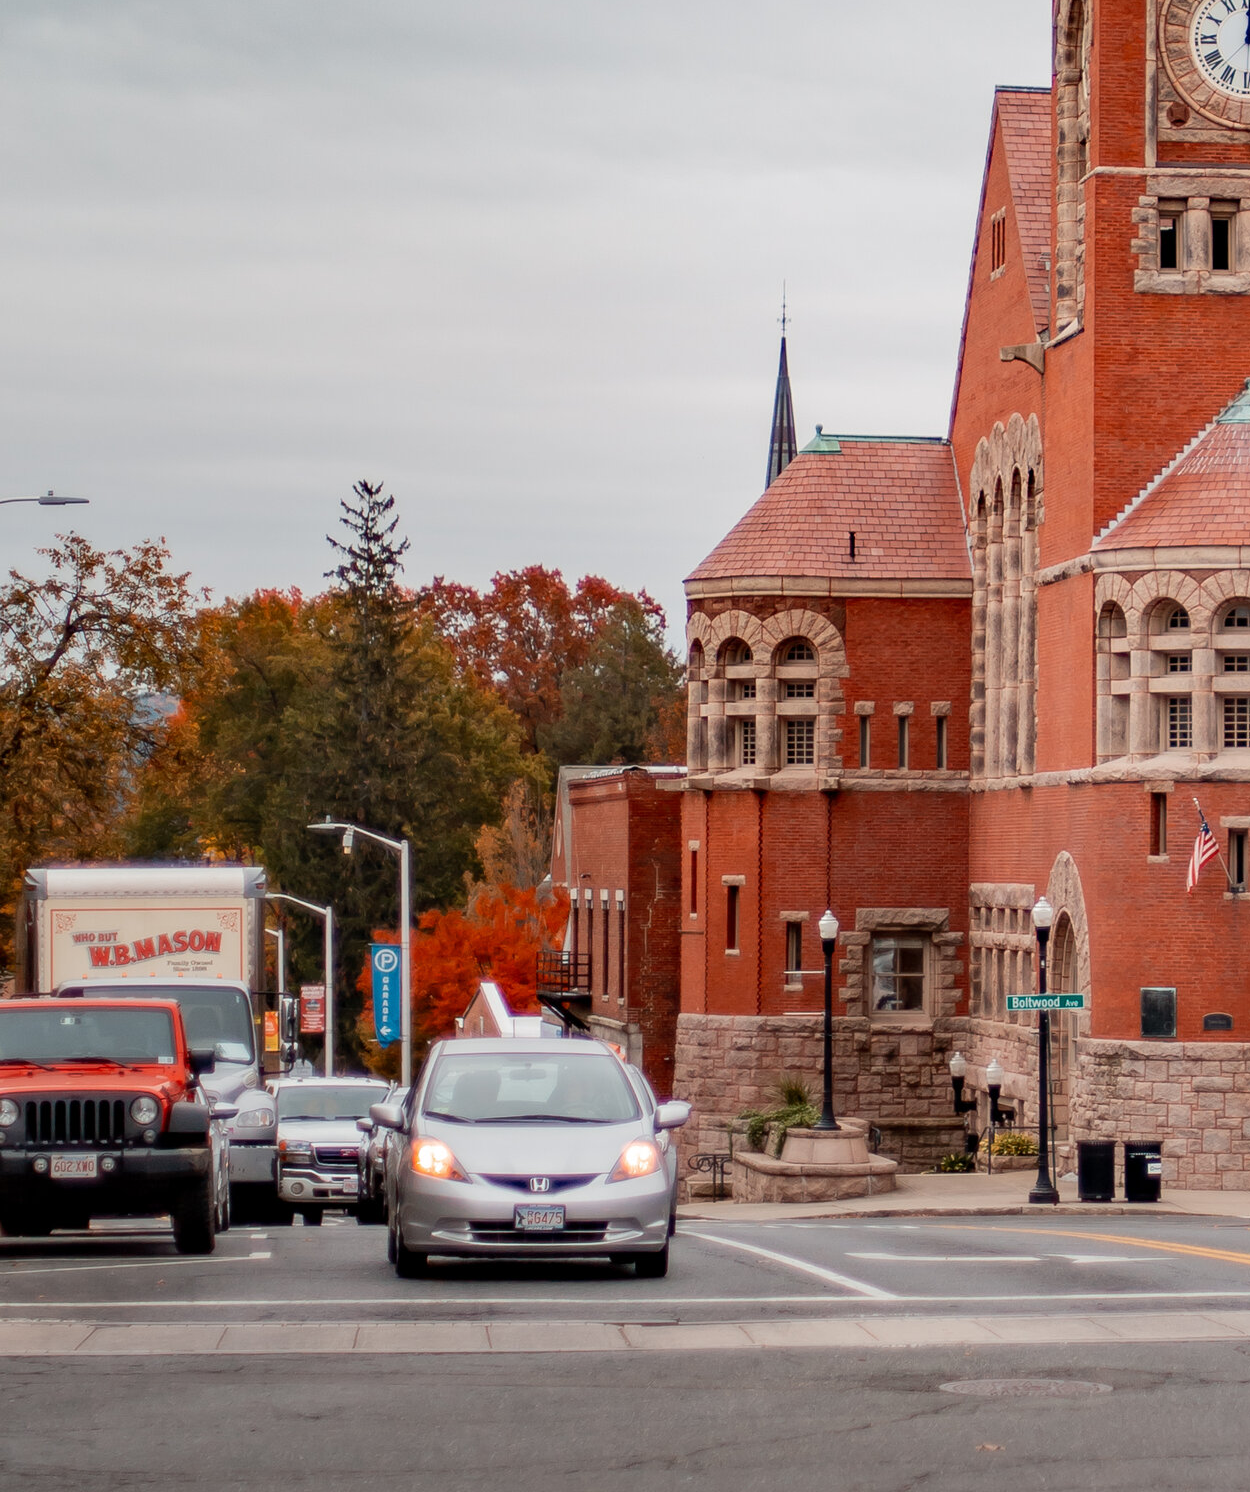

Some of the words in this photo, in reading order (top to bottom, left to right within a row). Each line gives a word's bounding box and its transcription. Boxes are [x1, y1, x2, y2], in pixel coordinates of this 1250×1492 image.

[72, 932, 96, 943] WHO
[98, 931, 118, 941] BUT
[381, 953, 393, 968] P
[382, 976, 390, 1023] GARAGE
[1012, 996, 1060, 1008] Boltwood
[1065, 999, 1079, 1007] Ave
[54, 1160, 73, 1173] 602
